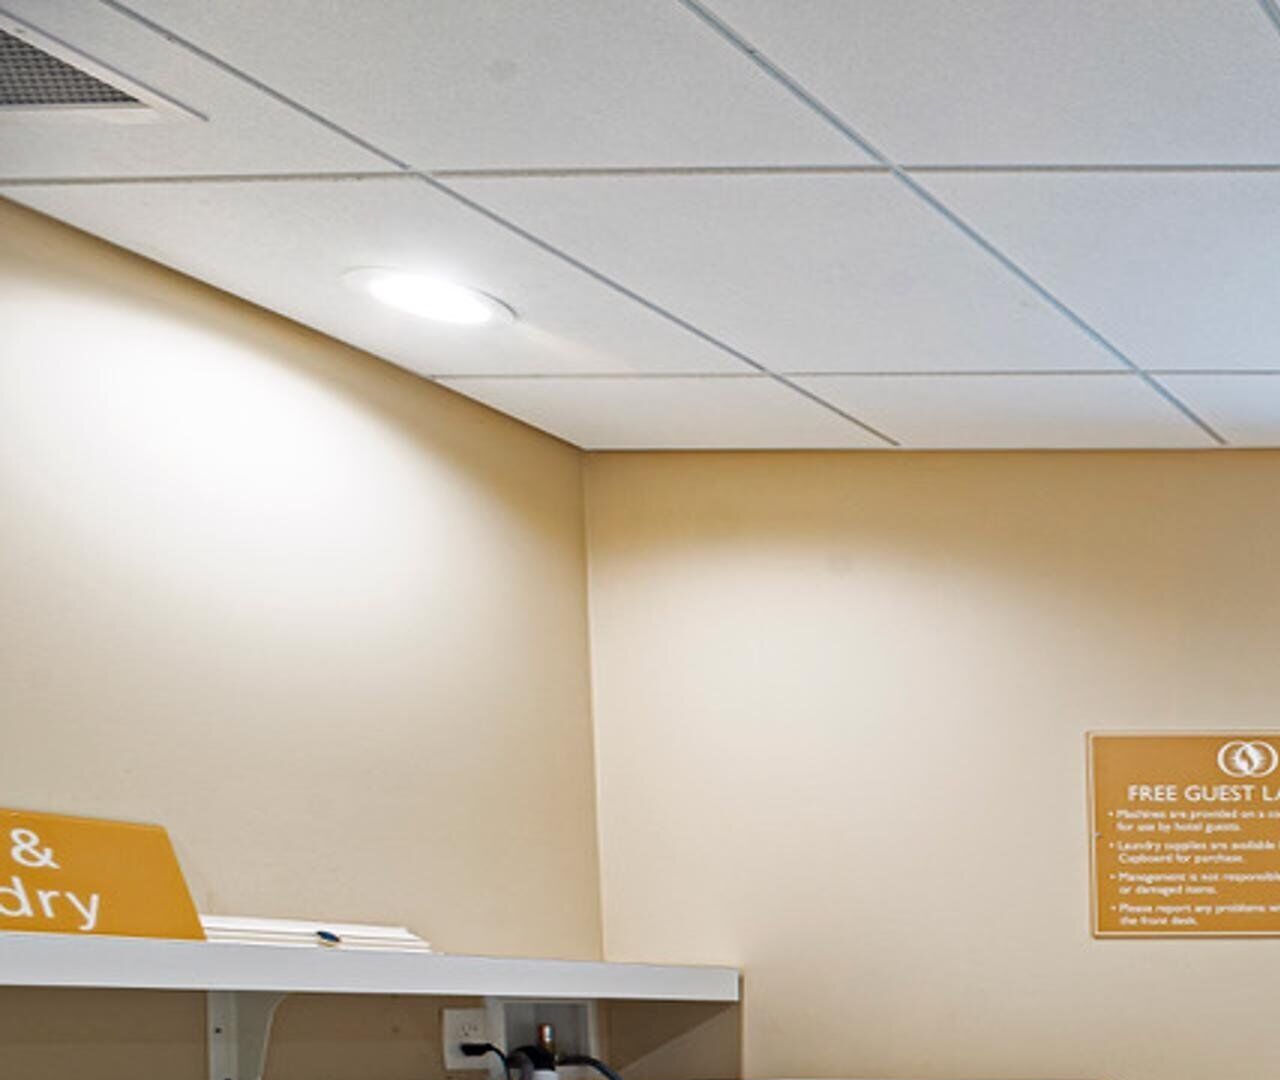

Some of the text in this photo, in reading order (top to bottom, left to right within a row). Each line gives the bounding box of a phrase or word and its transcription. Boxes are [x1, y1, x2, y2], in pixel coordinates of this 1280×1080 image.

[1128, 784, 1177, 801] FREE
[1184, 784, 1254, 802] GUEST
[1169, 811, 1186, 819] are
[1190, 809, 1237, 821] provided
[1240, 811, 1255, 819] on
[1116, 821, 1134, 831] for
[1137, 823, 1155, 832] use
[1158, 822, 1171, 834] by
[1175, 822, 1203, 832] hotel
[10, 828, 61, 870] &
[1118, 840, 1162, 852] Laundry
[1164, 841, 1207, 852] supplies
[1211, 842, 1228, 850] are
[1175, 852, 1192, 863] for
[1119, 872, 1186, 884] Management
[1119, 886, 1132, 895] or
[1136, 885, 1182, 897] damaged
[0, 876, 99, 931] dry
[1120, 903, 1153, 912] Please
[1155, 904, 1192, 915] report
[1195, 905, 1212, 914] any
[1215, 903, 1265, 914] problems
[1120, 916, 1138, 925] the
[1140, 915, 1168, 925] front
